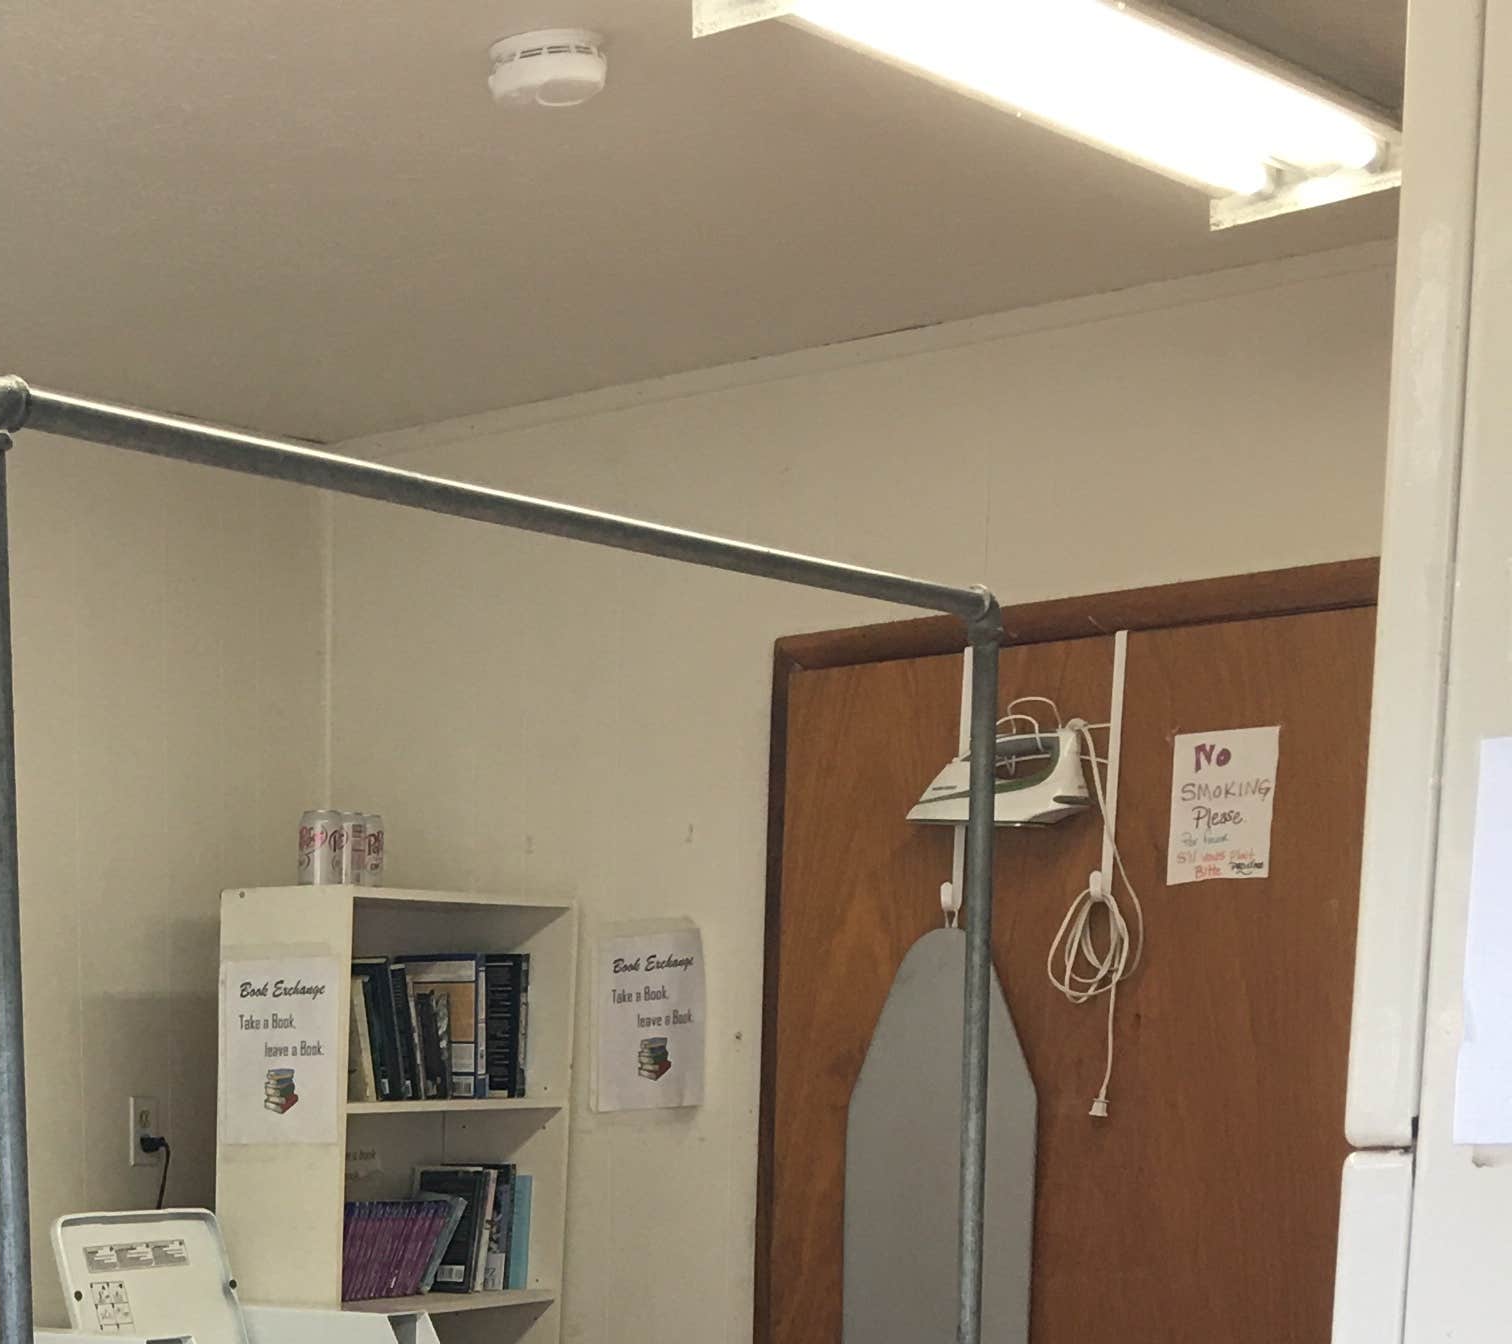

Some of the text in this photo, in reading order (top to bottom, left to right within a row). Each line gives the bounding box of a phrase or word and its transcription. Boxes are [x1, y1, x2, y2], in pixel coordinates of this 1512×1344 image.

[1180, 778, 1272, 802] SMOKING
[612, 953, 694, 974] Book Exchange
[239, 979, 326, 1000] Book Exchange
[611, 988, 633, 1005] Take
[635, 991, 642, 1002] a
[238, 1014, 261, 1030] Take
[263, 1018, 269, 1030] a
[637, 1013, 663, 1028] leave
[664, 1015, 671, 1026] a
[264, 1041, 289, 1057] leave
[291, 1046, 297, 1056] a
